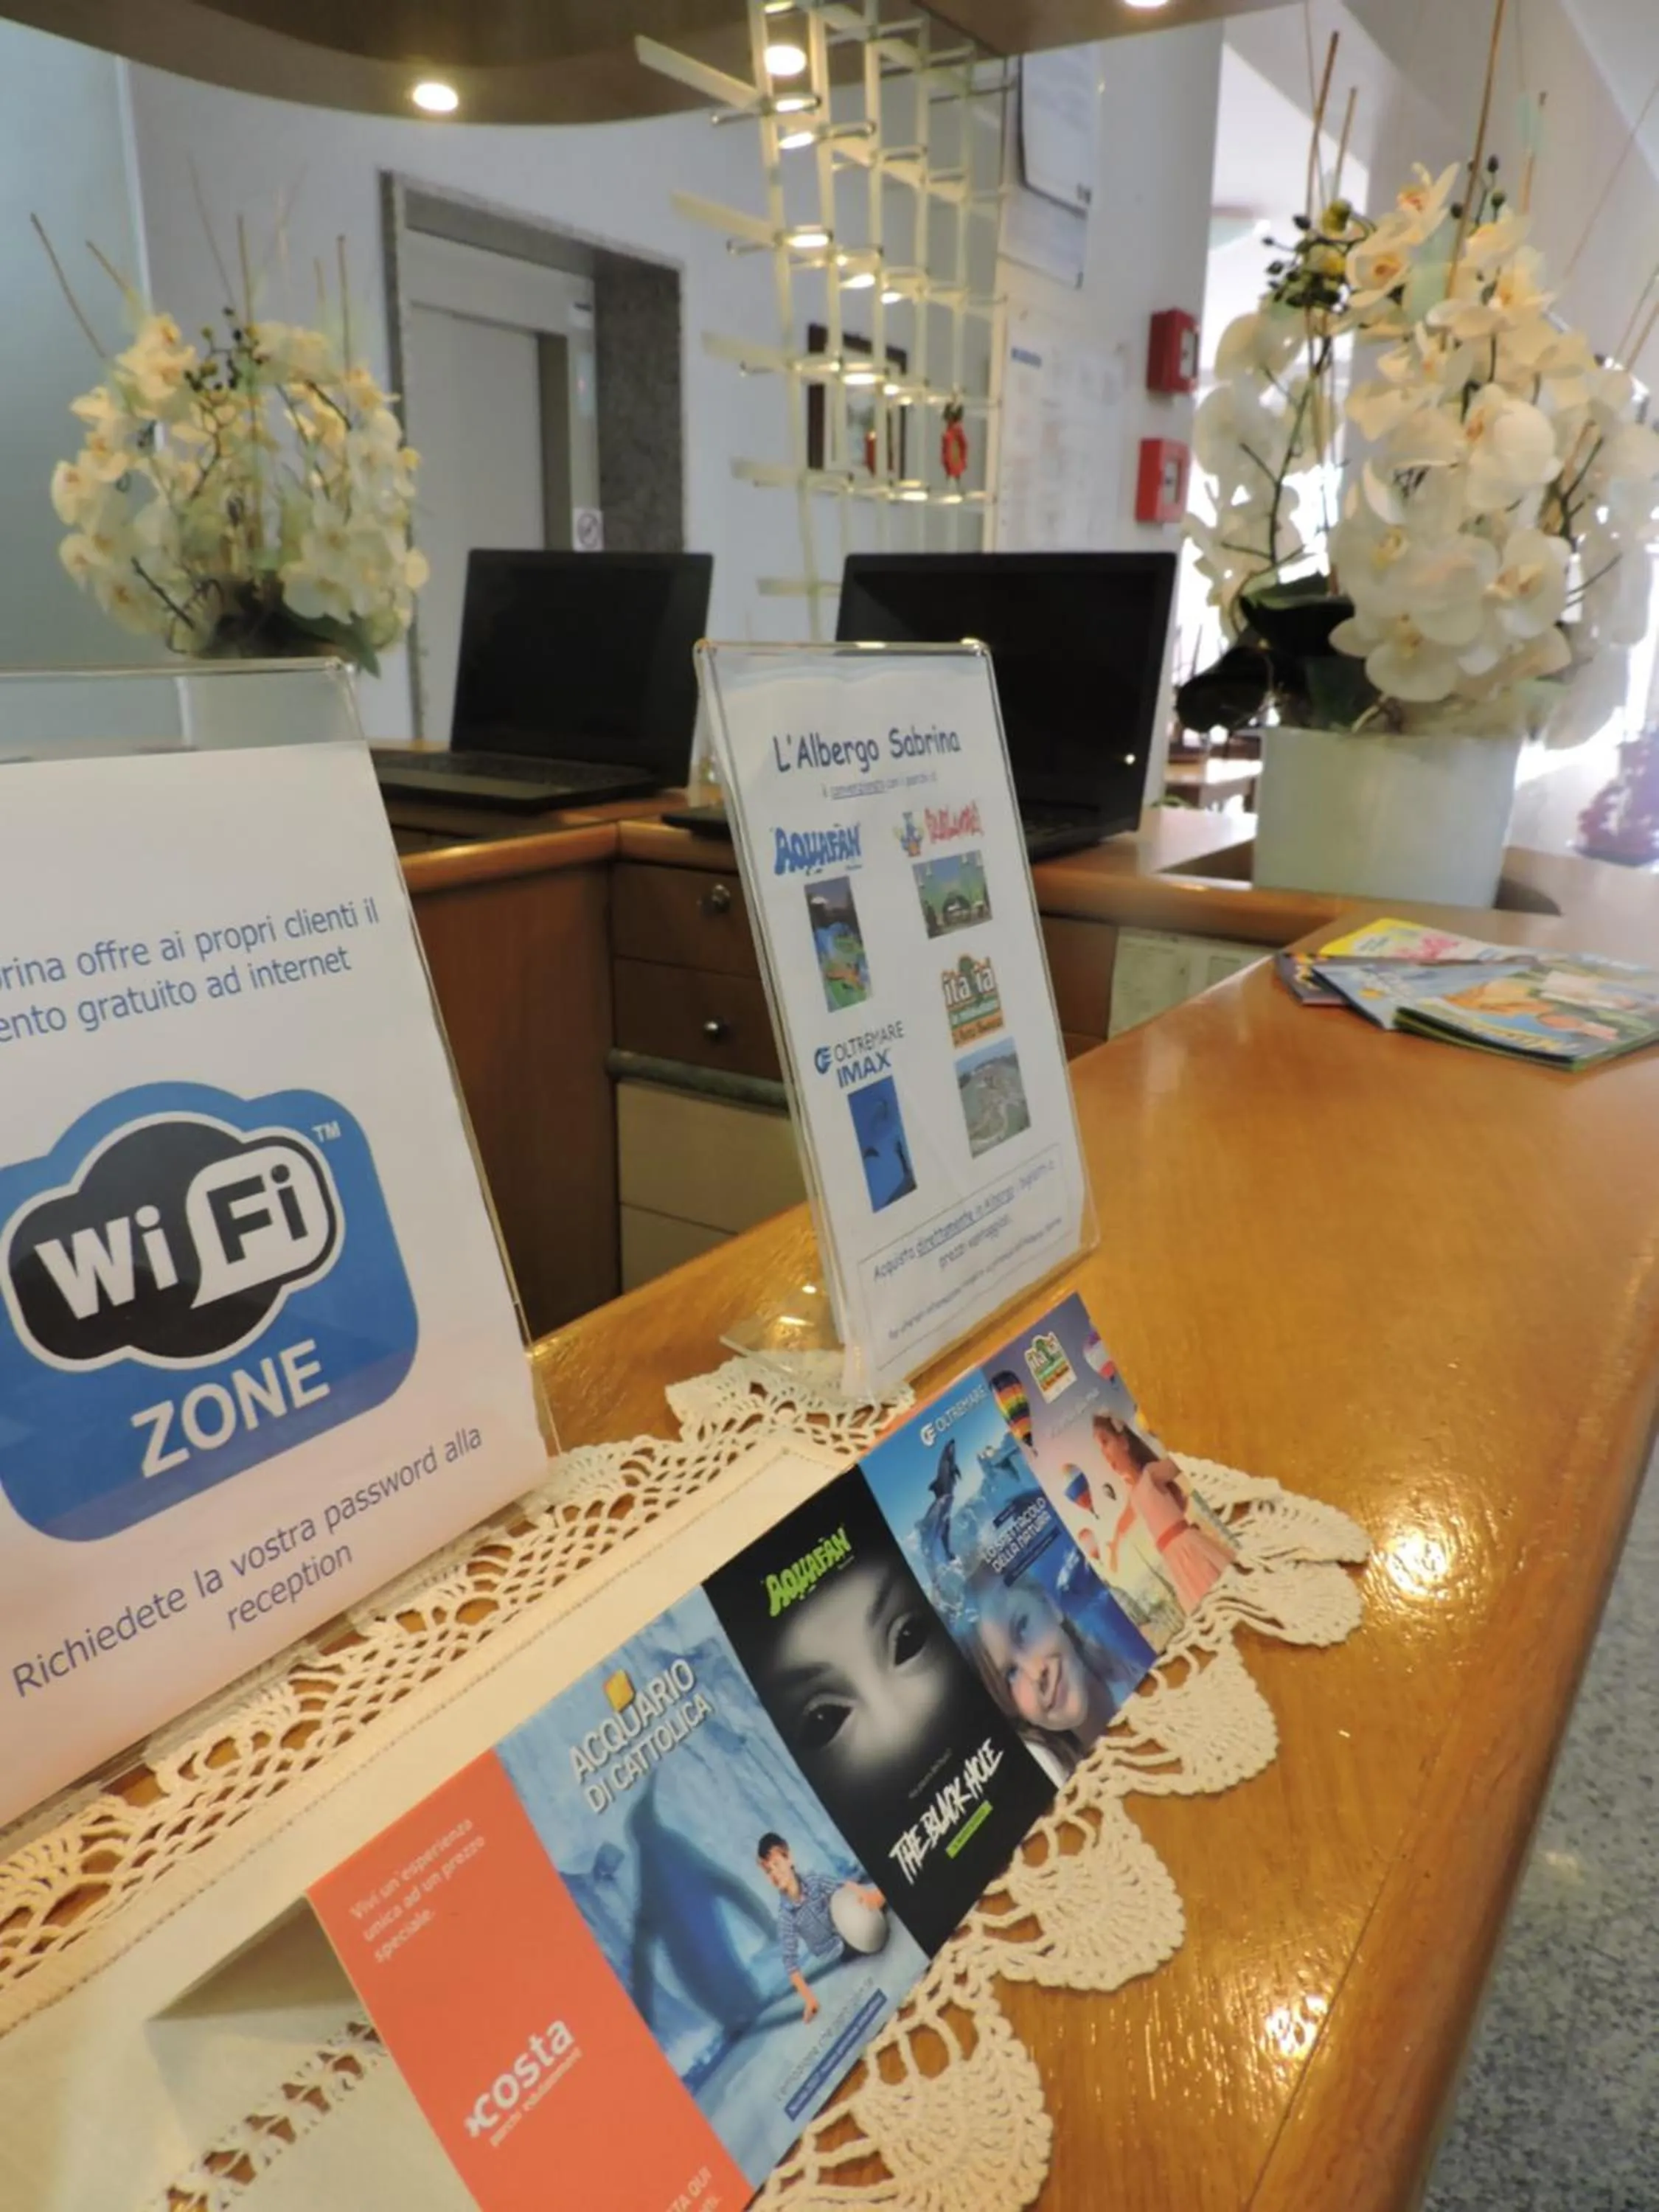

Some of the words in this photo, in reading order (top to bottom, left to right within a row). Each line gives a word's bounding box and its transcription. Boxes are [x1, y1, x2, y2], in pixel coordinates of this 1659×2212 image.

[773, 731, 880, 773] L'Albergo
[888, 724, 961, 759] Sabrina
[0, 956, 67, 990] rina
[77, 940, 150, 976] offre
[160, 931, 186, 961] ai
[195, 916, 277, 961] propri
[284, 900, 359, 939] clienti
[364, 897, 380, 925] il
[77, 979, 198, 1032] gratuito
[206, 966, 242, 999] ad
[249, 945, 352, 990] internet
[837, 1048, 891, 1089] IMAX
[131, 1339, 330, 1478] ZONE
[11, 1587, 188, 1697] Richiedete
[194, 1568, 225, 1599] la
[230, 1519, 318, 1577] vostra
[324, 1446, 438, 1535] password
[444, 1424, 483, 1464] alla
[226, 1542, 354, 1631] reception
[569, 1659, 695, 1784] ACQUARIO
[585, 1778, 615, 1814] DI
[611, 1694, 713, 1790] CATTOLICA
[888, 1823, 932, 1886] THE
[920, 1775, 973, 1850] BLACK
[962, 1737, 1005, 1801] HOLE
[472, 2020, 576, 2129] costa
